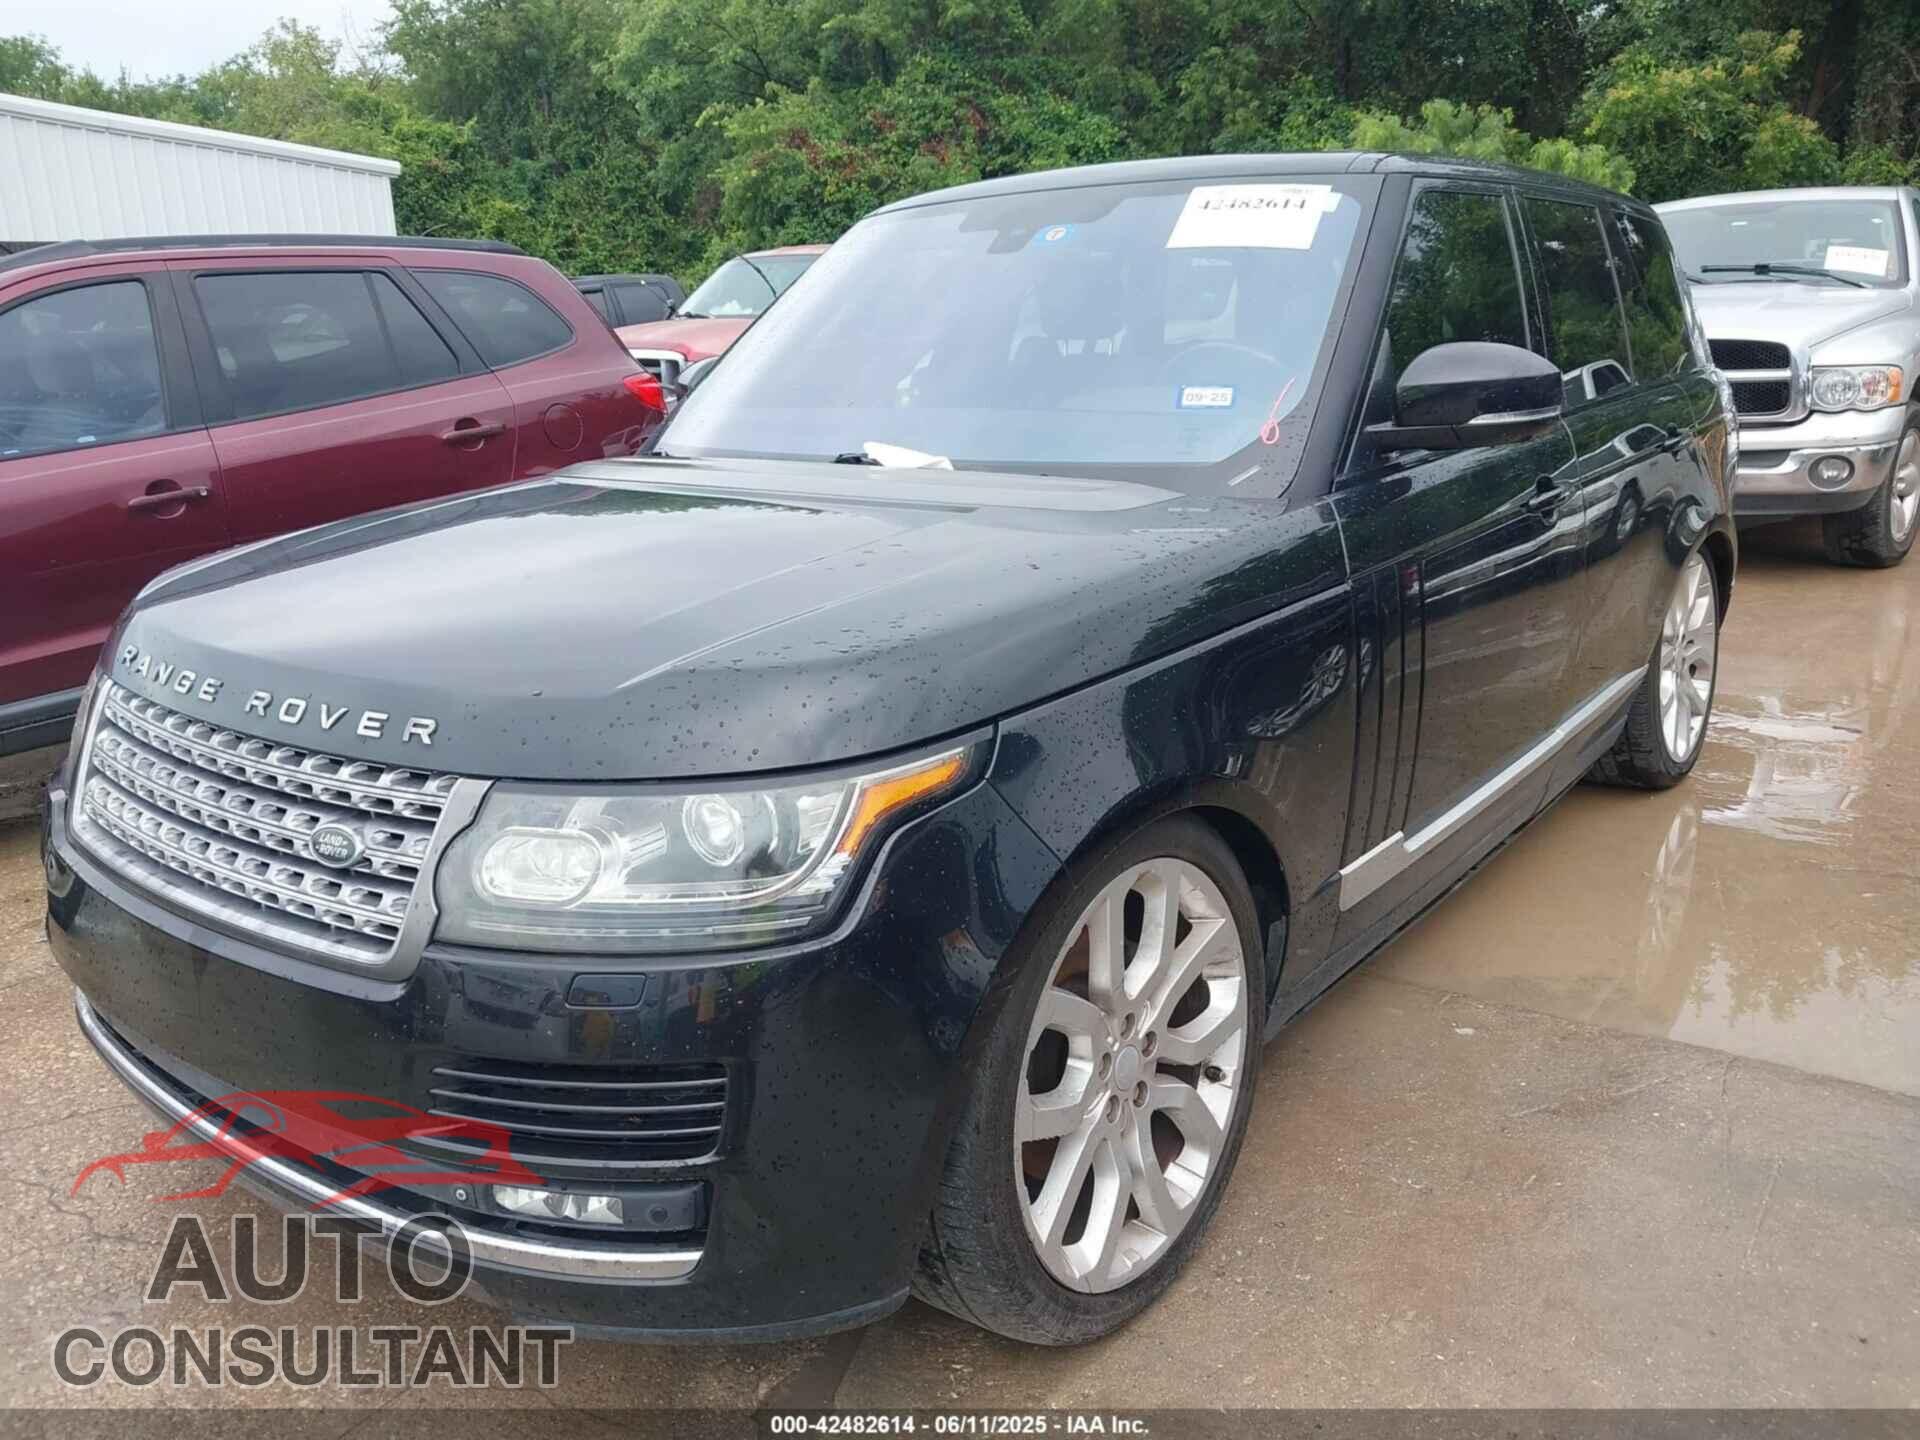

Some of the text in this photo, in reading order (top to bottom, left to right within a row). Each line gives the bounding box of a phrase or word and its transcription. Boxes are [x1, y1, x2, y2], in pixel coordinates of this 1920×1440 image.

[1198, 197, 1308, 211] 42482614
[1185, 391, 1229, 403] 09-25
[121, 644, 438, 745] RANGE ROVER
[318, 832, 344, 847] LAND
